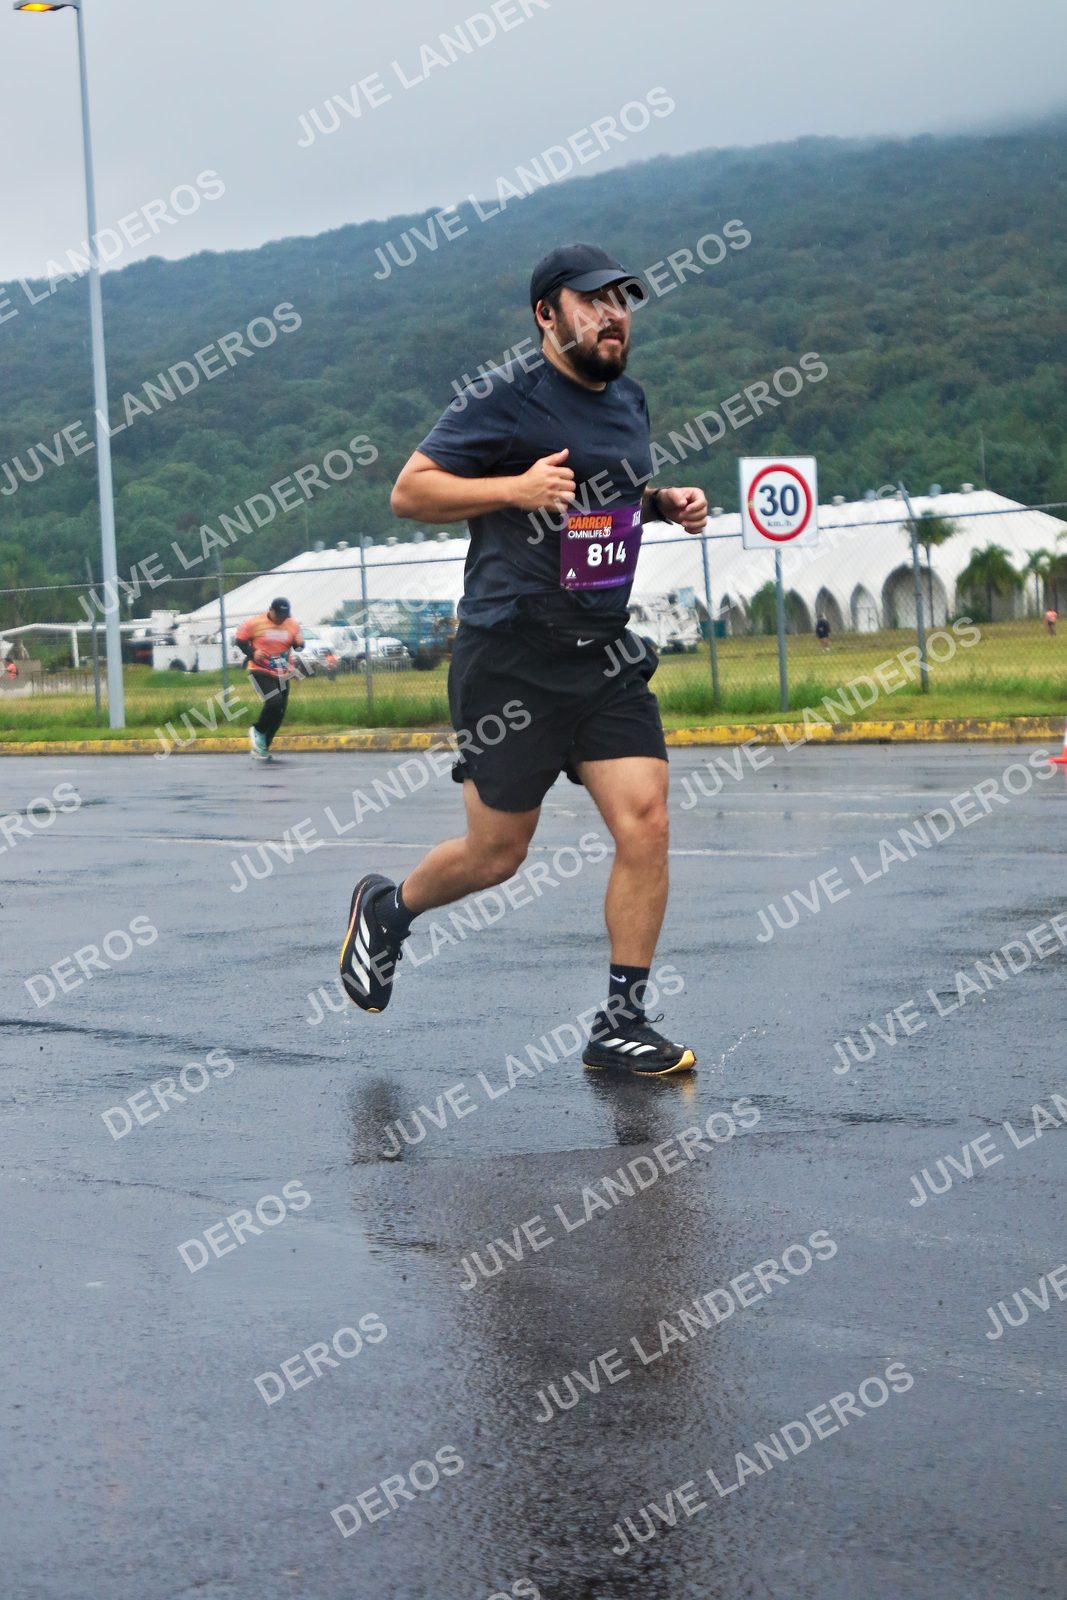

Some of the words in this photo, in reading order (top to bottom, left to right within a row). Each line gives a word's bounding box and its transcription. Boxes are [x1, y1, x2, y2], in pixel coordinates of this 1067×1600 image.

[758, 484, 800, 516] 30
[568, 515, 613, 530] CARRERA
[568, 529, 602, 539] OMNILIFE
[587, 541, 626, 567] 814
